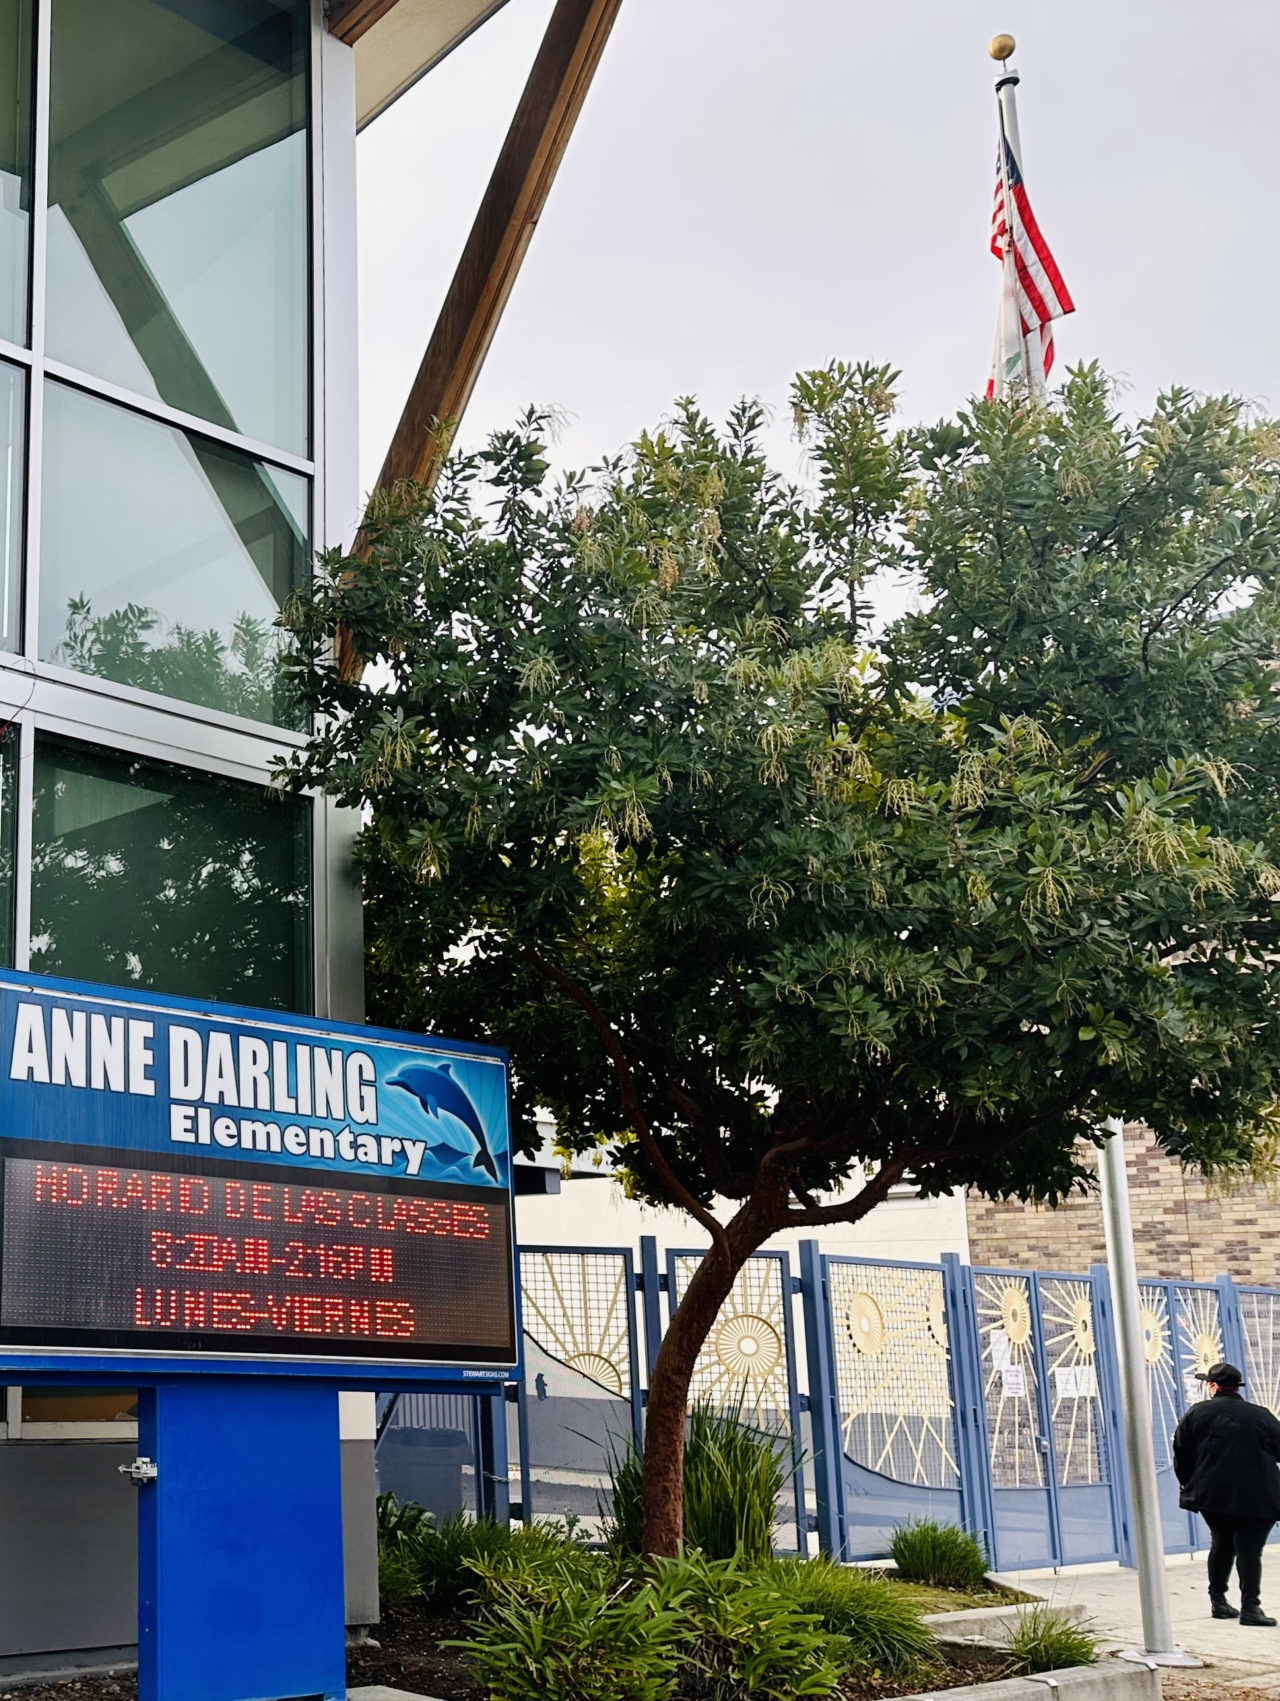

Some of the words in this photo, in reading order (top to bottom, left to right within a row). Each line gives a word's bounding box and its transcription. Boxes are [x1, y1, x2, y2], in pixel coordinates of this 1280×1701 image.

[10, 1002, 156, 1096] ANNE
[168, 1024, 378, 1126] DARLING
[169, 1103, 427, 1176] Elementary
[225, 1182, 272, 1221] DE
[283, 1187, 342, 1226] LAS
[347, 1193, 490, 1239] CLASSES
[134, 1287, 415, 1337] LUNES-VIERNES
